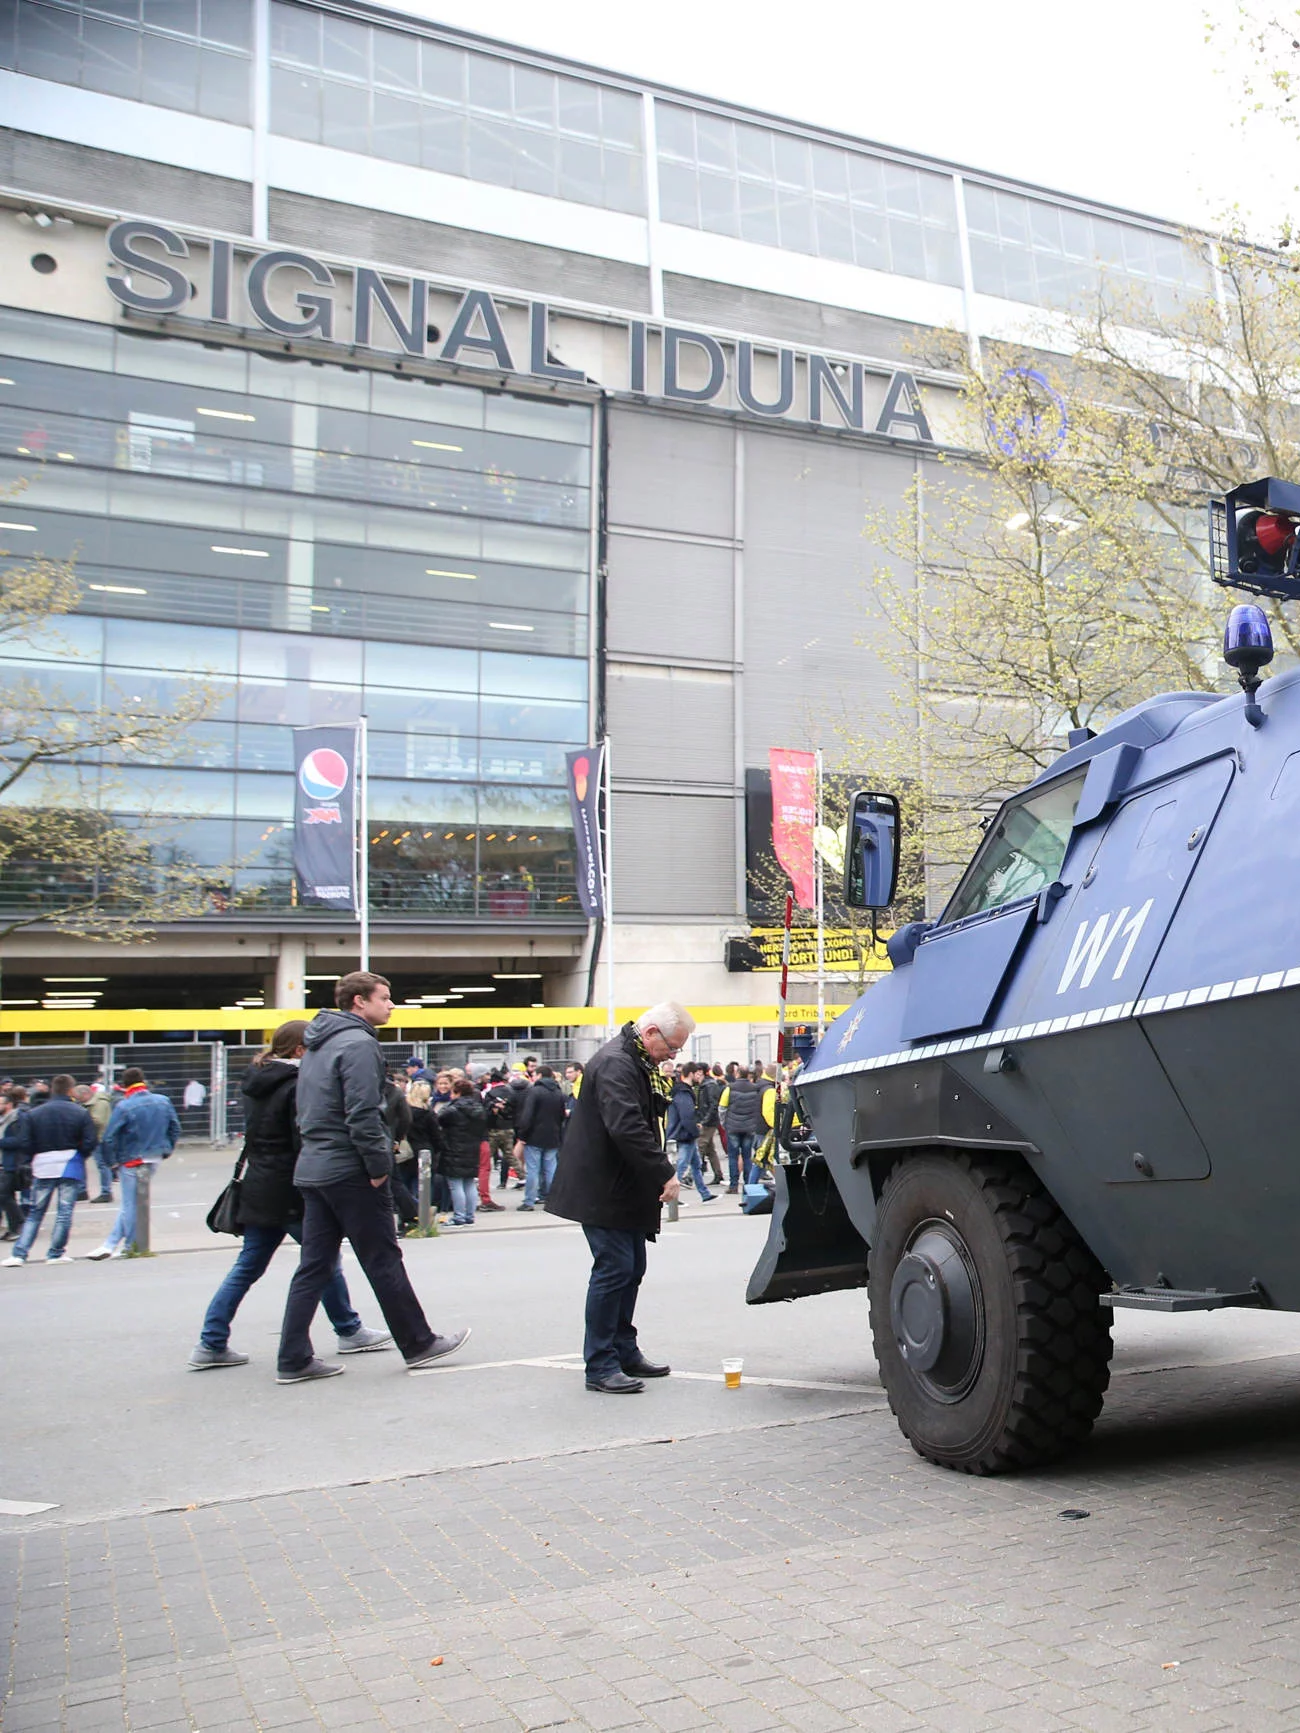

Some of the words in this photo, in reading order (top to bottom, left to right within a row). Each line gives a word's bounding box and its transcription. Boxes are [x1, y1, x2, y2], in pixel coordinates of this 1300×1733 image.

[105, 220, 588, 385] SIGNAL
[628, 320, 935, 441] IDUNA
[760, 940, 806, 953] HERZICH
[1056, 898, 1154, 994] W1
[767, 953, 780, 966] IN
[788, 949, 854, 964] ORTUND!
[800, 1009, 836, 1017] Tribne
